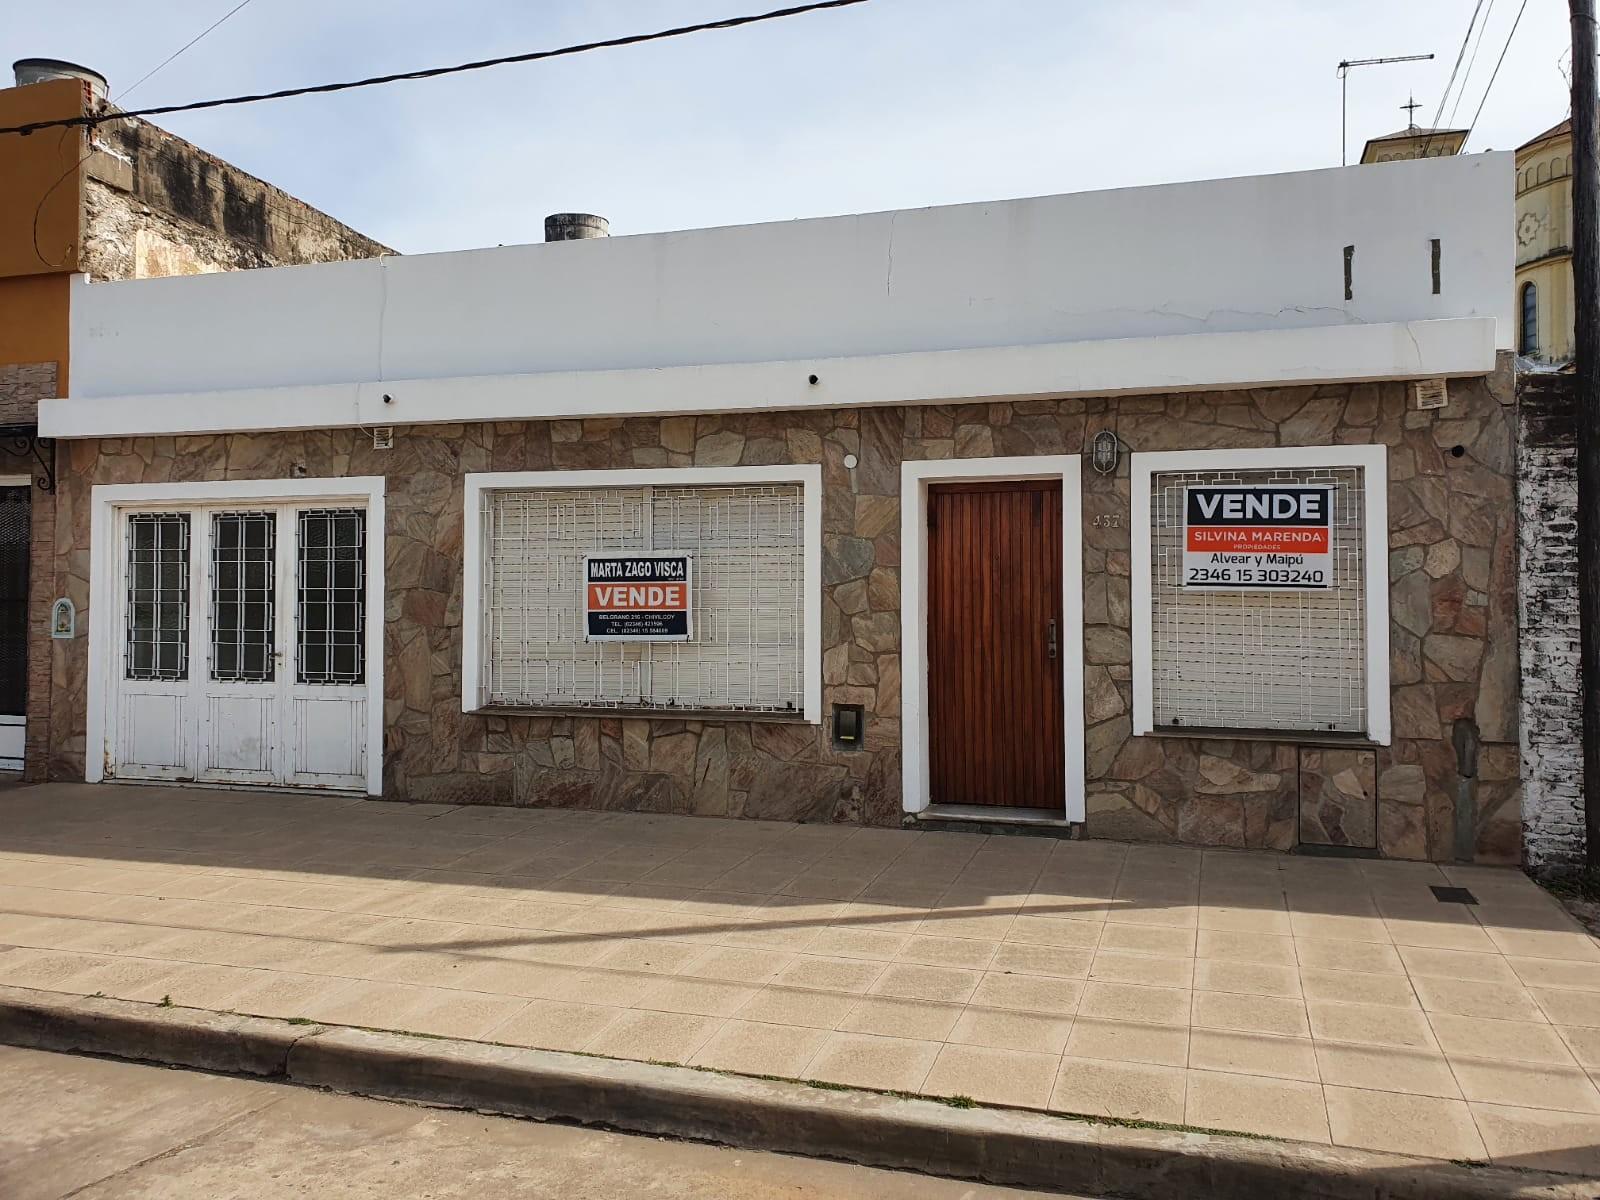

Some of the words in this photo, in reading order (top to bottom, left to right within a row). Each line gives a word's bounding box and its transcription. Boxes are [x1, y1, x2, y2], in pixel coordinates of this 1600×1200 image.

[1196, 493, 1321, 519] VENDE
[1194, 531, 1247, 542] SILVINA
[1252, 531, 1322, 542] MARENDA
[1211, 553, 1251, 564] Alvear
[1255, 555, 1262, 567] y
[1266, 554, 1304, 567] Maipú
[590, 562, 623, 577] MARTA
[625, 561, 652, 577] ZAGO
[654, 561, 684, 577] VISCA
[1189, 568, 1231, 581] 2346
[1236, 570, 1252, 581] 15
[1257, 570, 1323, 583] 303240
[595, 586, 680, 607] VENDE
